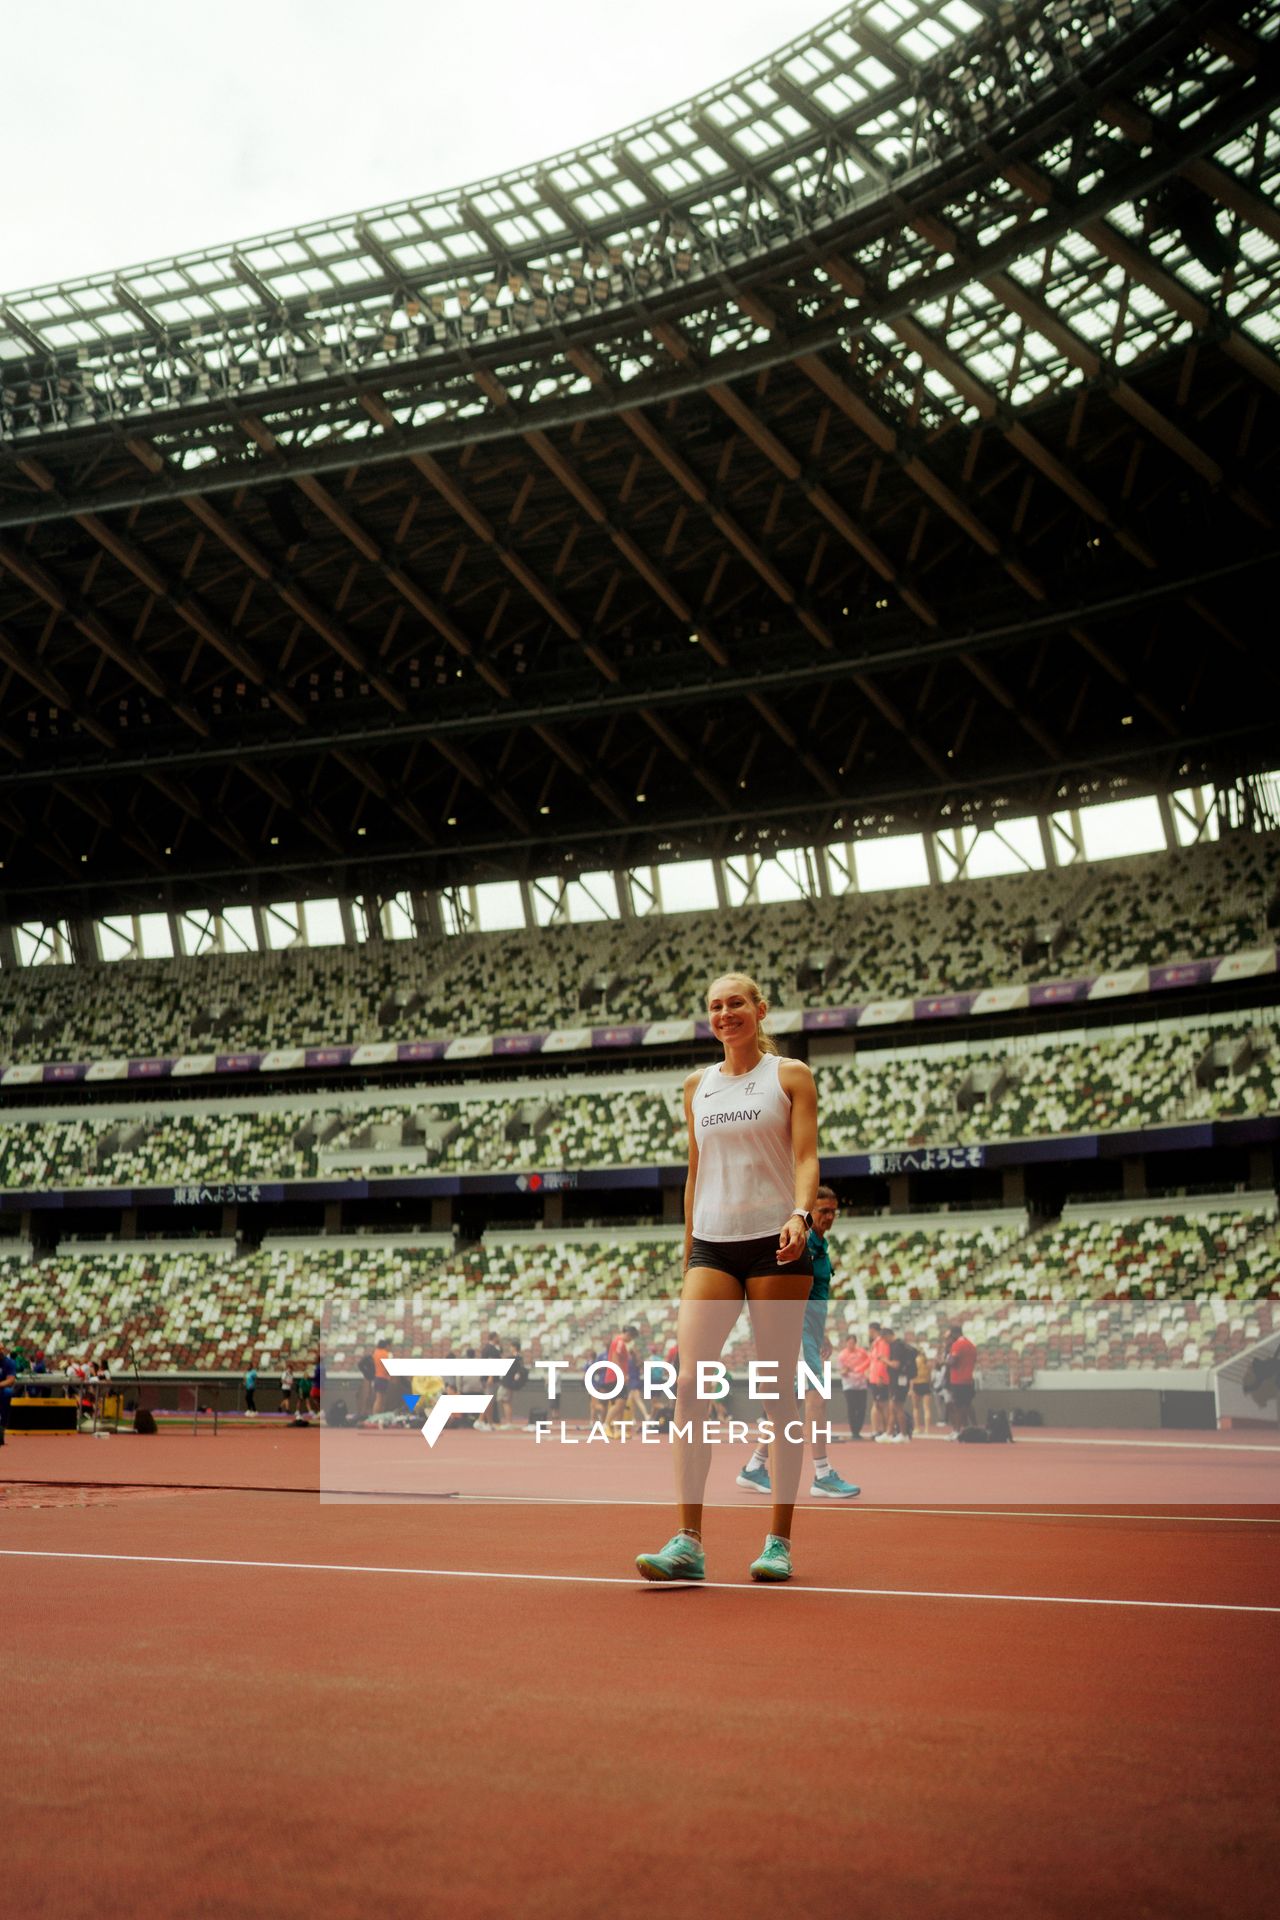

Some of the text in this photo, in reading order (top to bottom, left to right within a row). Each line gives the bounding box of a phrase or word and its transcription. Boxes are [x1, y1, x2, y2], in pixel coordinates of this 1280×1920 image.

[701, 1110, 762, 1128] GERMANY
[868, 1147, 982, 1175] 東京へようこそ
